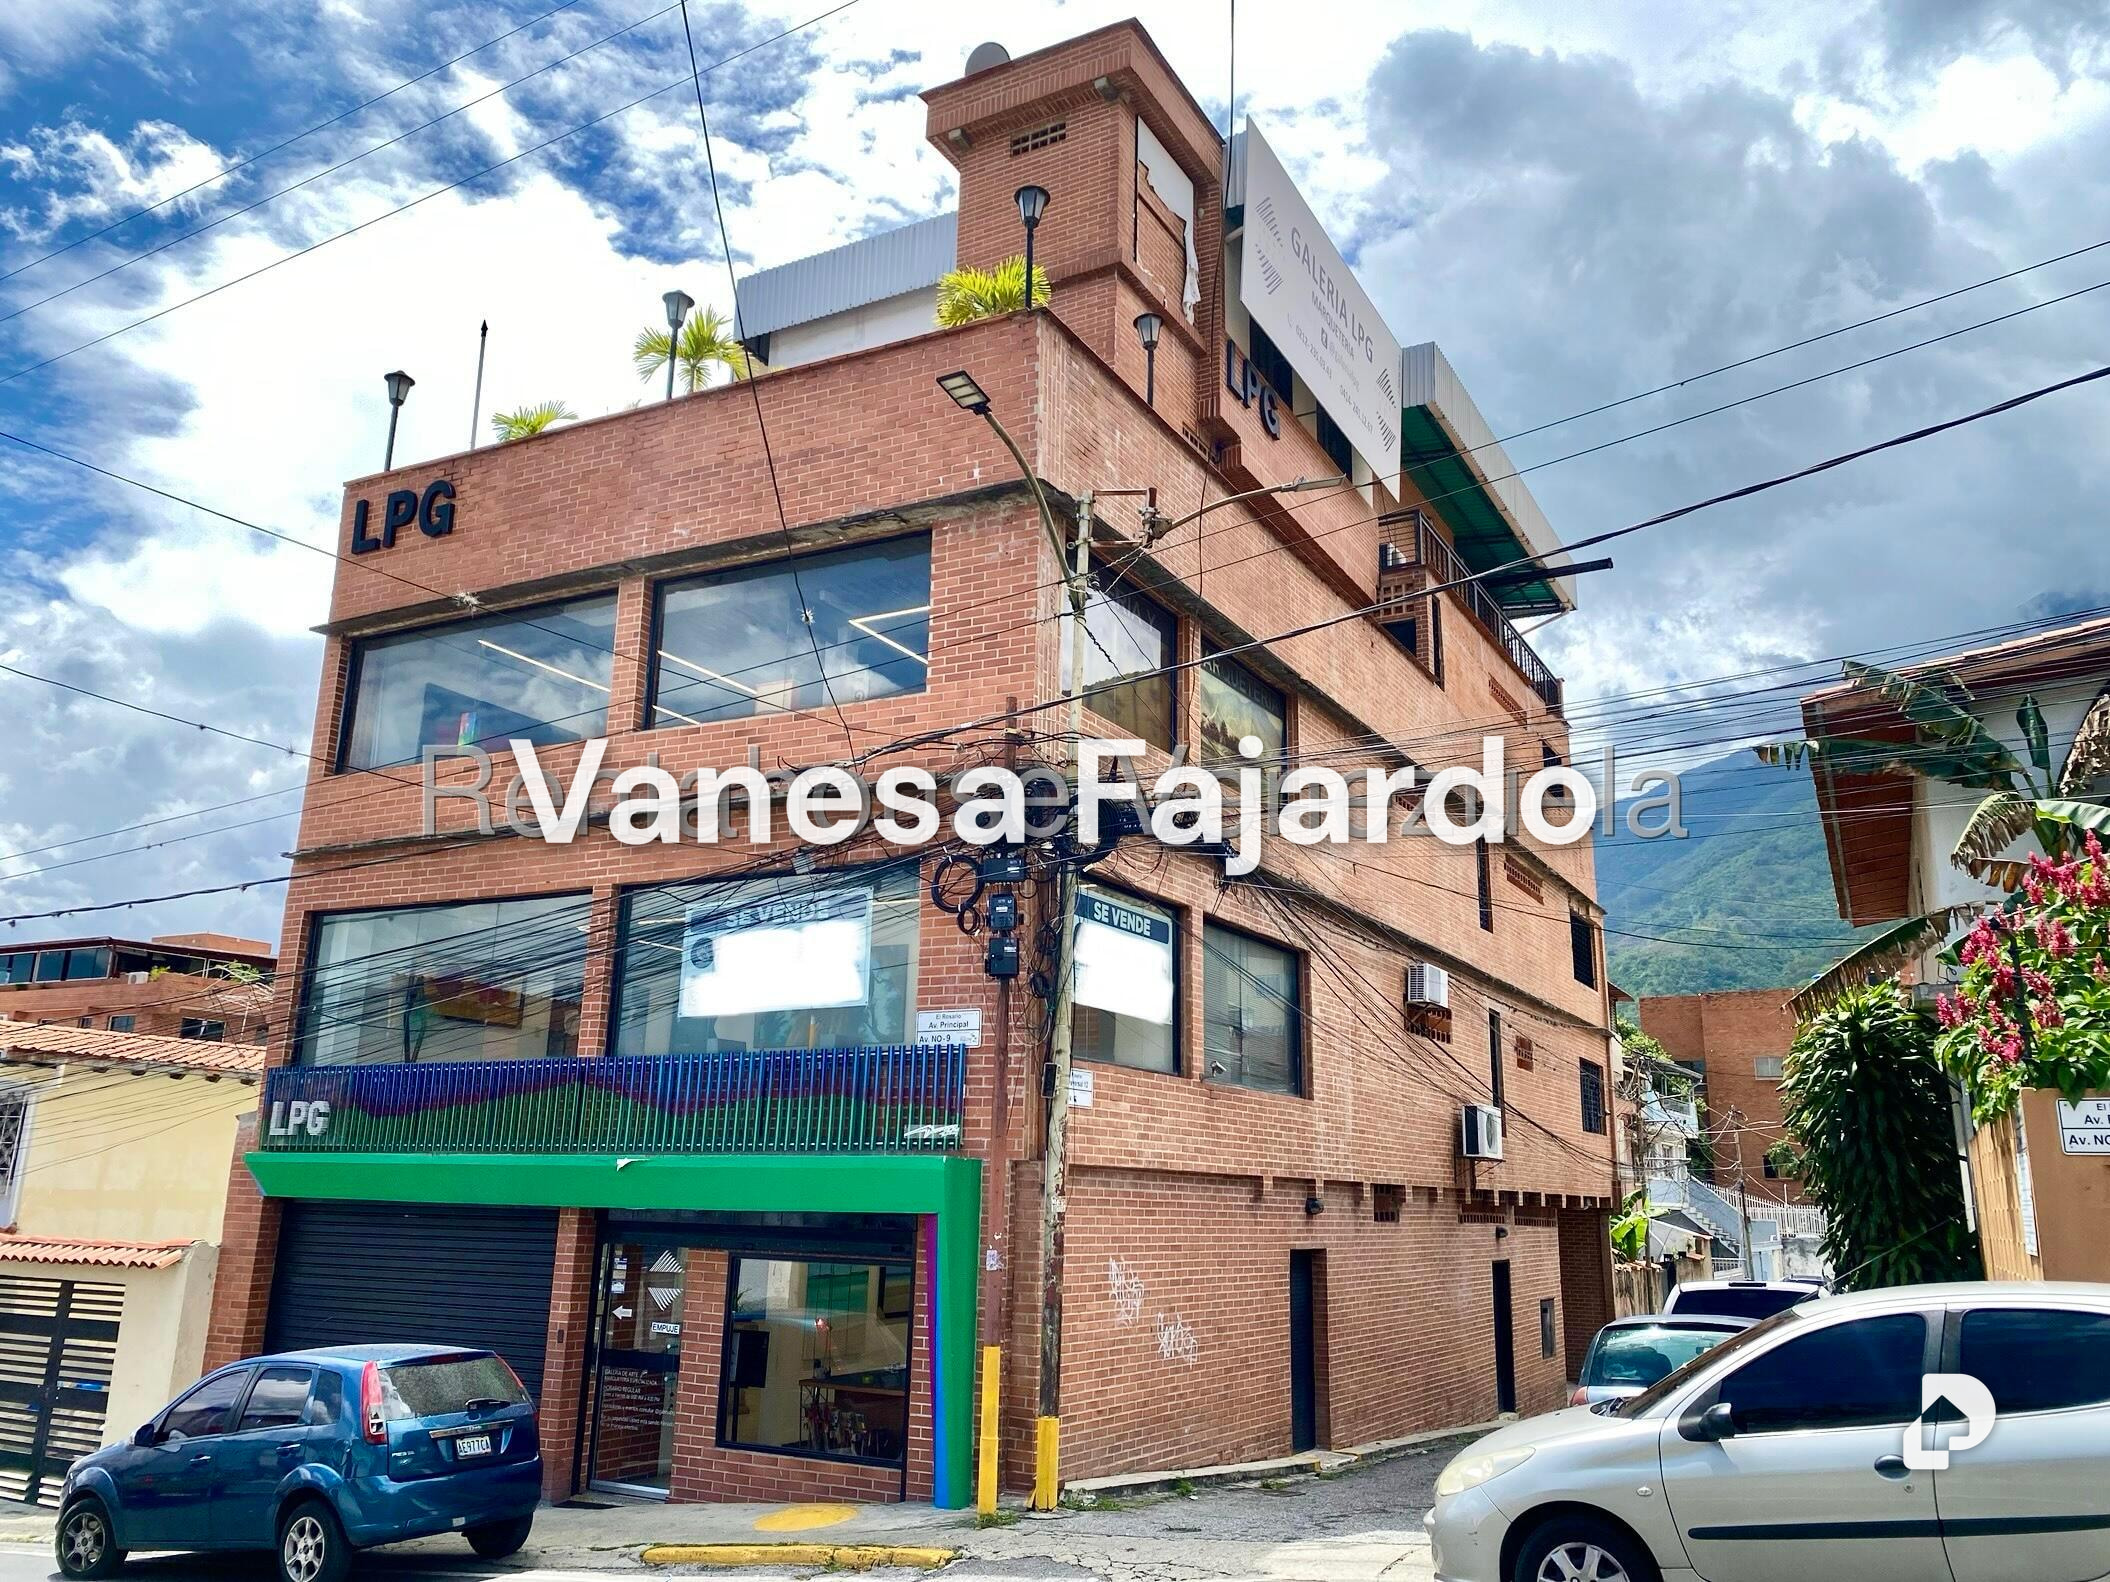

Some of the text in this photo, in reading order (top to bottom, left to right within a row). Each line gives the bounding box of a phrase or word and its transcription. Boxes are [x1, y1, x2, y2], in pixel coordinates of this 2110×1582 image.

[1291, 227, 1373, 364] GALERIA LPG
[1312, 290, 1355, 360] MARQUETERIA
[1227, 339, 1280, 441] LPG
[351, 480, 456, 554] LPG
[726, 899, 829, 927] SE VENDE
[1094, 902, 1151, 937] SE VENDE
[940, 1020, 969, 1029] Principal
[269, 1100, 331, 1136] LPG
[2084, 1114, 2104, 1125] Av.
[2096, 1103, 2106, 1111] El
[2069, 1134, 2092, 1145] Av.
[653, 1323, 679, 1333] EMPUJE
[458, 1438, 490, 1454] AE977CA
